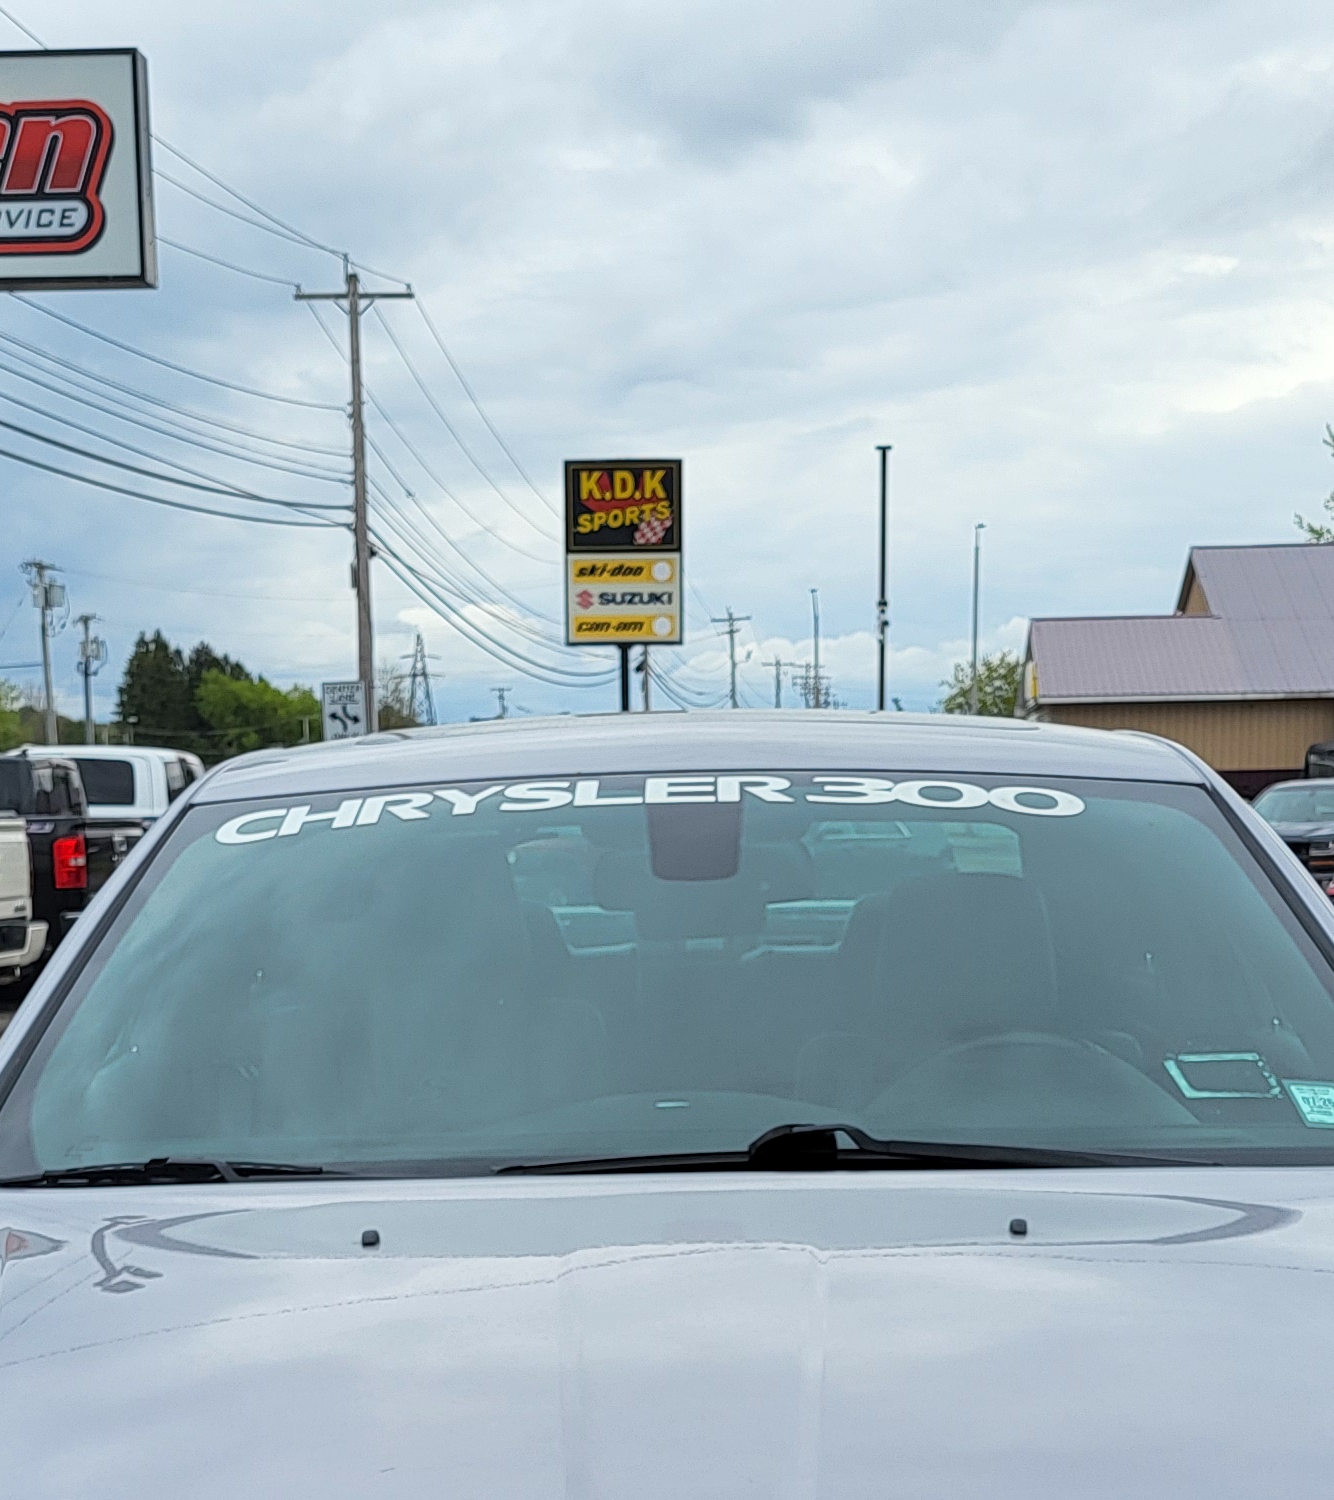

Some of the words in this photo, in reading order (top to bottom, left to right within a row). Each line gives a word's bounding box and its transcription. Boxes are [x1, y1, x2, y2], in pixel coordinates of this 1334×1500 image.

[576, 500, 672, 534] SPORTS
[598, 591, 674, 606] SUZUKI
[215, 775, 795, 845] CHRYSLER
[804, 775, 1086, 818] 300
